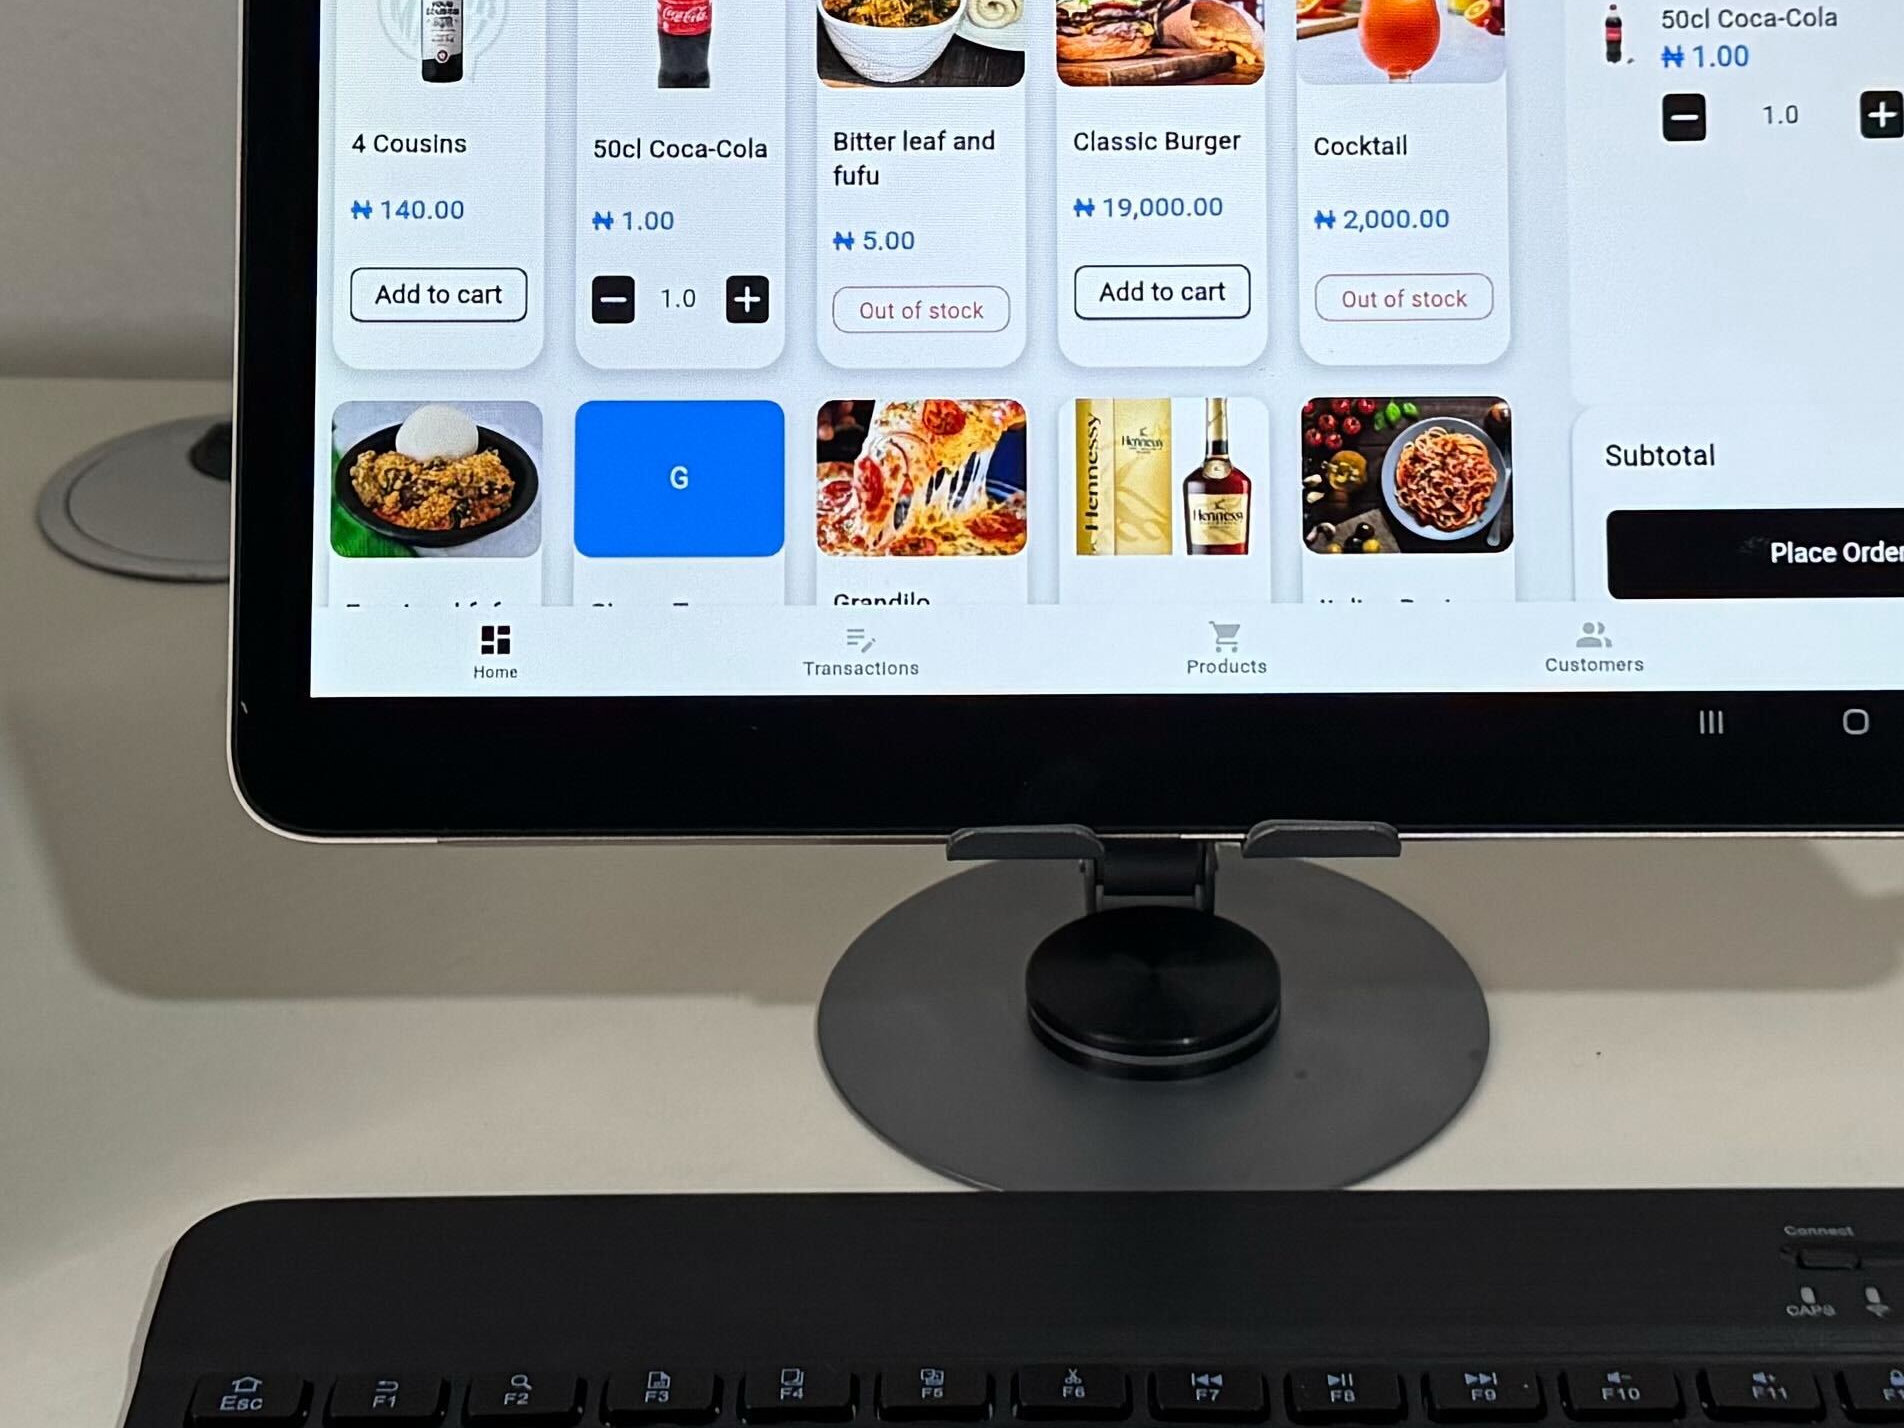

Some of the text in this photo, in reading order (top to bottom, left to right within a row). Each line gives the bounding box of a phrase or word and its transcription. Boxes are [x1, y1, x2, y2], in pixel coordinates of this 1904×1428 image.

[1662, 6, 1837, 29] 50cl Coca-Cola
[1693, 45, 1749, 68] 1.00
[1763, 105, 1798, 124] 1.0
[352, 134, 466, 153] 4 Cousins
[594, 138, 767, 159] 50cl Coca-Cola
[834, 129, 994, 151] Bitter leaf and
[1074, 130, 1241, 155] Classic Burger
[1315, 134, 1407, 155] Cocktail
[833, 164, 878, 186] fufu
[381, 200, 463, 219] 140.00
[1104, 197, 1222, 220] 19,000.00
[623, 211, 674, 230] 1.00
[1344, 209, 1449, 233] 2,000.00
[864, 231, 914, 250] 5.00
[375, 283, 502, 304] Add to cart
[662, 289, 695, 308] 1.0
[1099, 281, 1225, 302] Add to cart
[1343, 289, 1467, 308] Out of stock
[860, 300, 983, 319] Out of stock
[1606, 444, 1714, 466] Subtotal
[670, 466, 688, 489] G
[1085, 413, 1101, 530] Hennessy
[1771, 541, 1837, 563] Place
[474, 666, 517, 678] Home
[803, 662, 918, 676] Transactions
[1188, 658, 1267, 674] Products
[1546, 658, 1643, 672] Customers
[504, 1393, 528, 1404] F2
[645, 1391, 668, 1402] F3
[781, 1388, 803, 1399] F4
[922, 1388, 943, 1398] F5
[1063, 1386, 1085, 1397] F6
[1196, 1389, 1219, 1401] F7
[1331, 1390, 1355, 1402] F8
[1472, 1389, 1496, 1400] F9
[1602, 1388, 1640, 1400] F10
[1752, 1386, 1787, 1399] F11
[220, 1395, 262, 1410] Esc
[373, 1396, 395, 1407] F1
